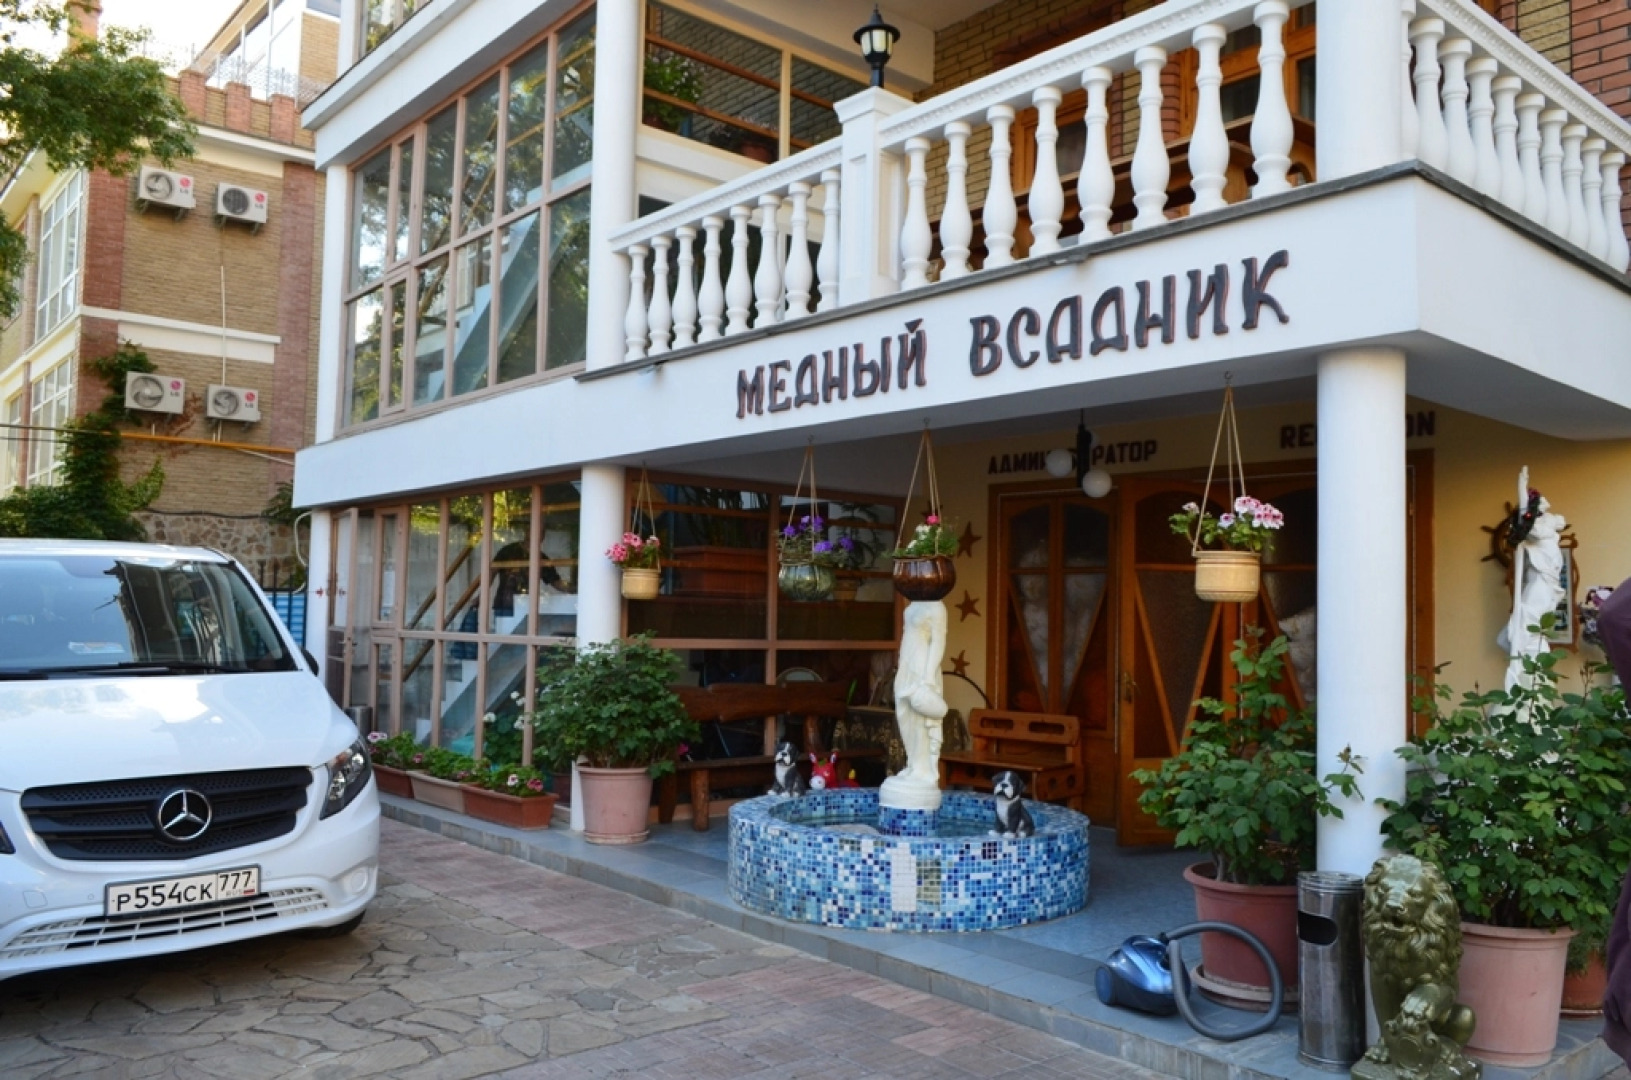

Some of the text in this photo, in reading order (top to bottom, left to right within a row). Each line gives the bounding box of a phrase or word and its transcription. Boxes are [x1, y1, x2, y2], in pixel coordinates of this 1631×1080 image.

[736, 250, 1290, 419] МЕДНЫЙ ВСАДНИК
[219, 871, 252, 891] 777
